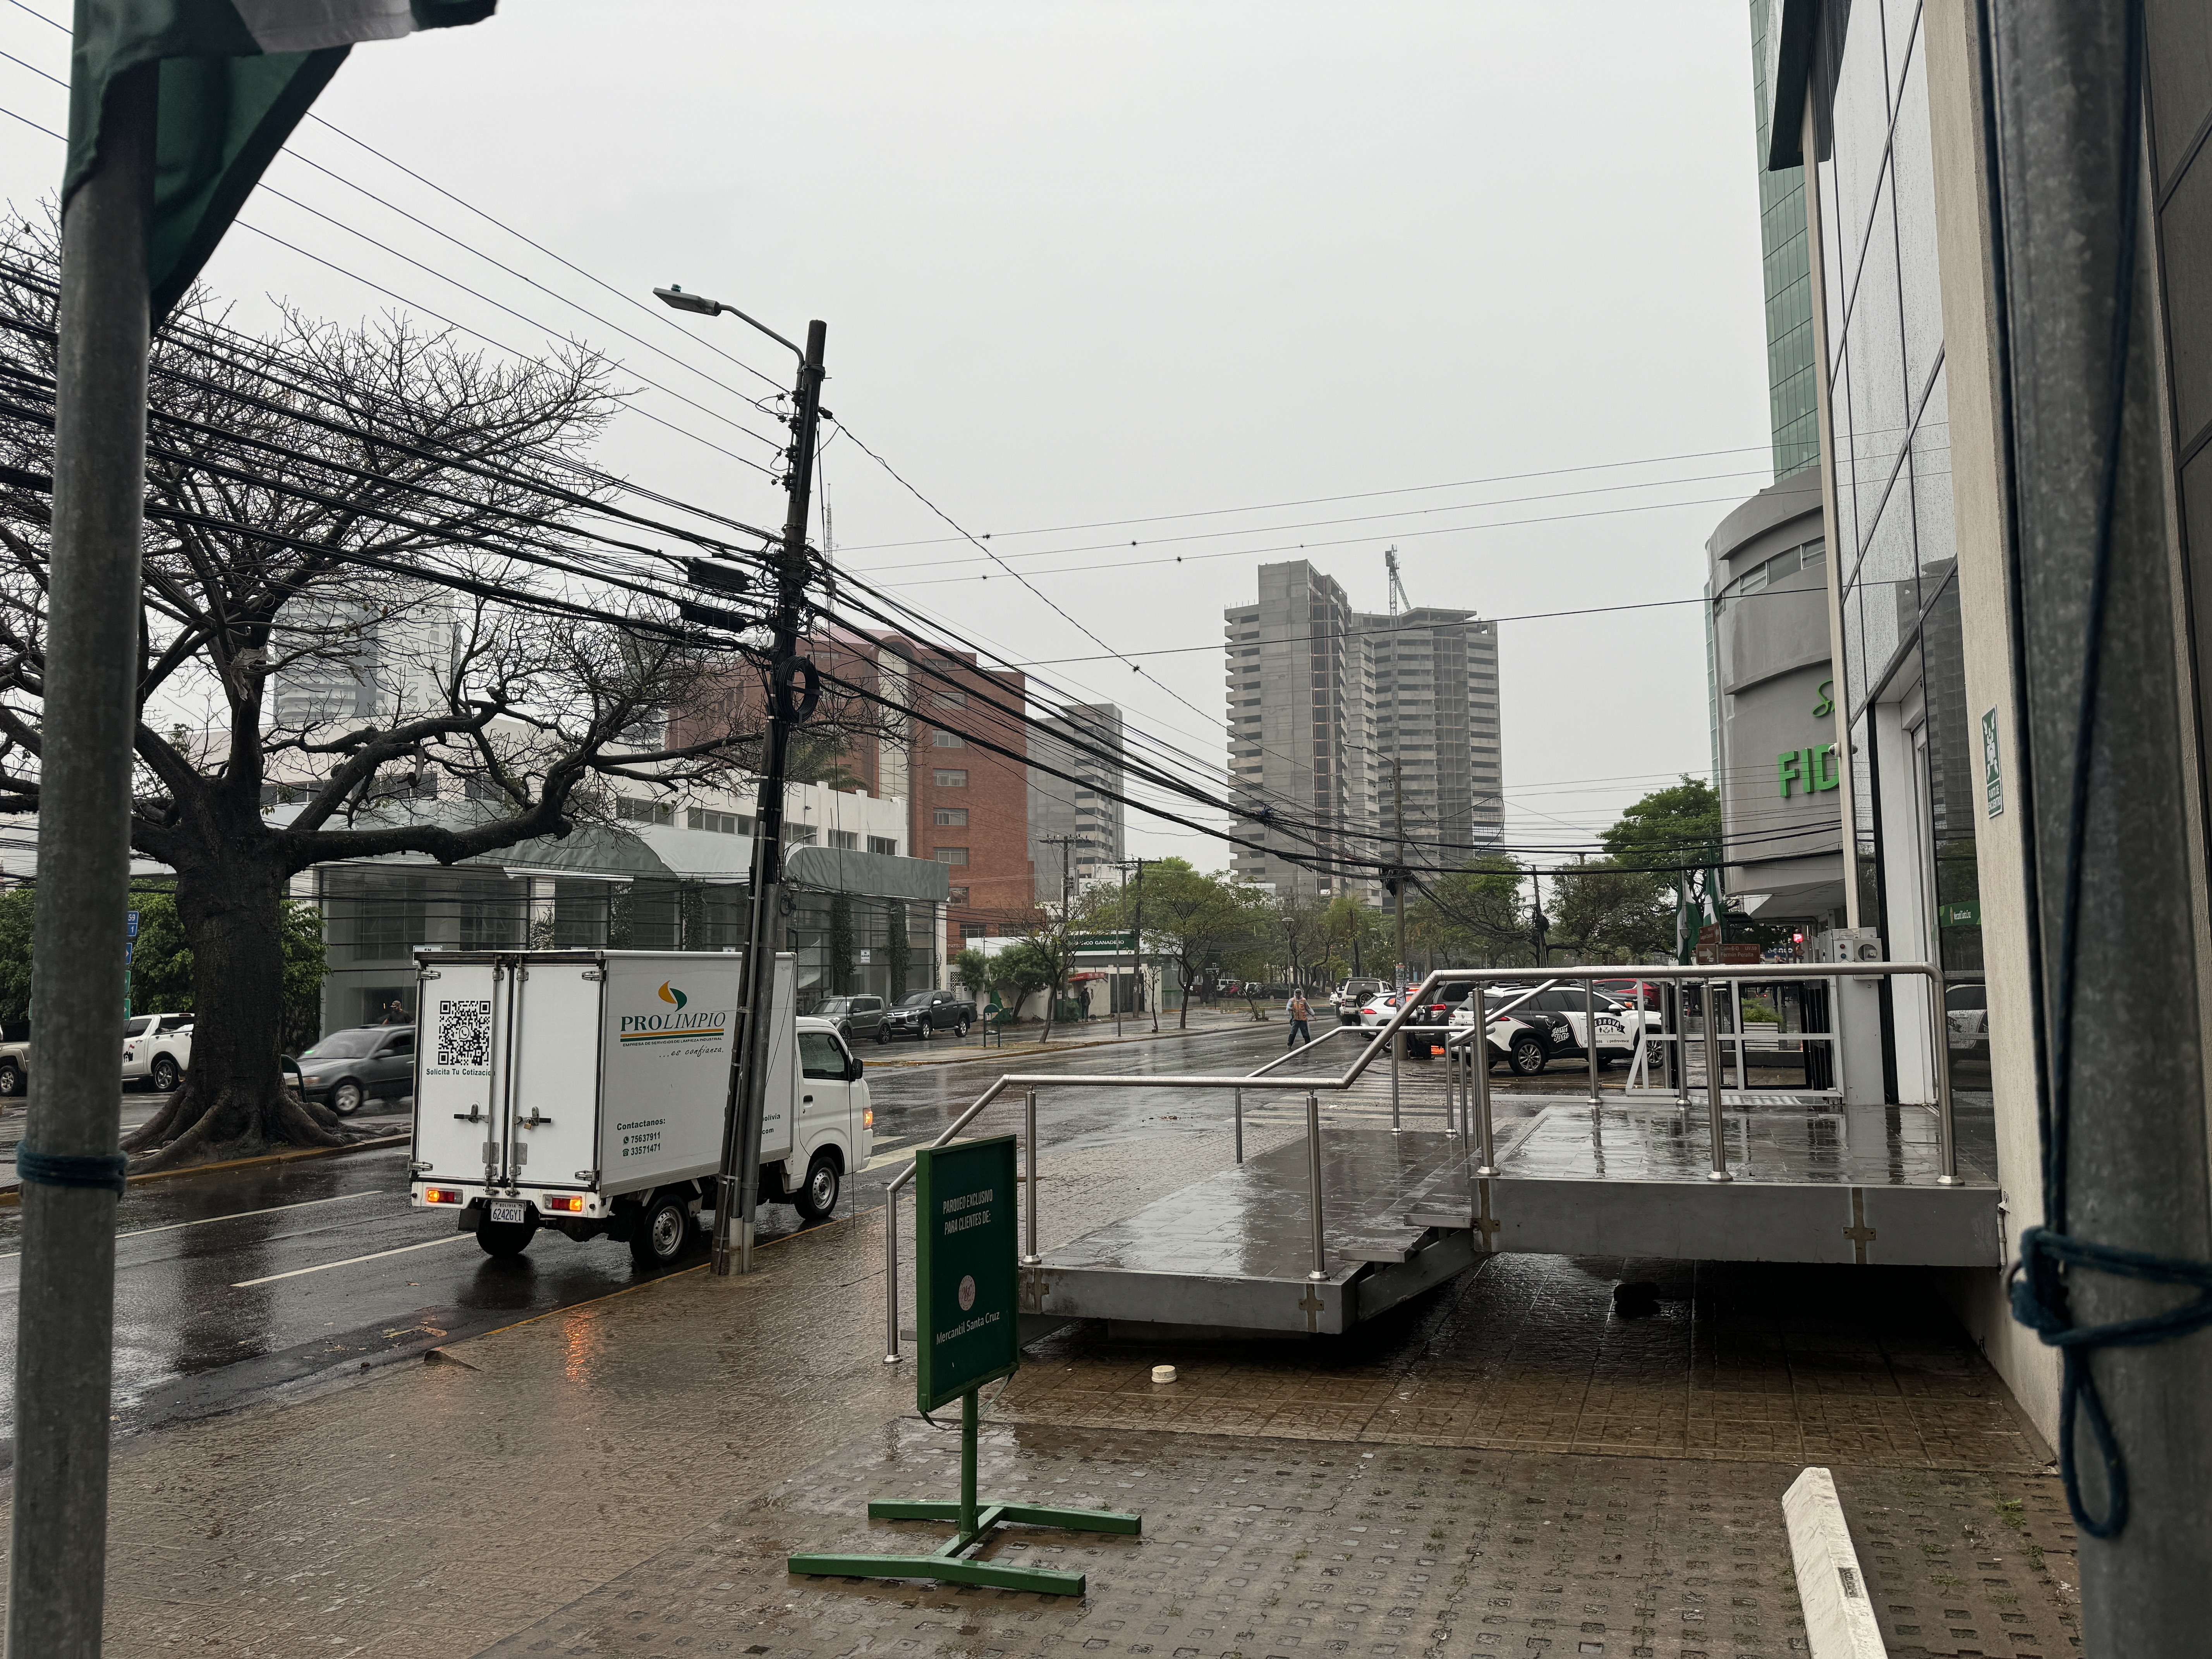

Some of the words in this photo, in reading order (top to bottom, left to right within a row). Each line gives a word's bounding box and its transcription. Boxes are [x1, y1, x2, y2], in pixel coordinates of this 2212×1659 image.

[1996, 784, 1999, 795] DE
[620, 1012, 726, 1032] PROLIMPIO
[1594, 1019, 1620, 1027] EDROVA
[685, 1045, 724, 1057] confianza.
[617, 1118, 665, 1130] Contactanos:
[631, 1131, 660, 1143] 75637911
[631, 1143, 660, 1156] 33571471
[943, 1195, 966, 1214] PARQUEO
[966, 1189, 993, 1208] EXCLUSIVO
[493, 1208, 521, 1221] 6242GYI
[945, 1219, 958, 1235] PARA
[958, 1212, 982, 1231] CLIENTES
[982, 1210, 991, 1224] DE:
[936, 1321, 965, 1345] Mercantil
[966, 1317, 984, 1332] Santa
[985, 1312, 1000, 1324] Cruz
